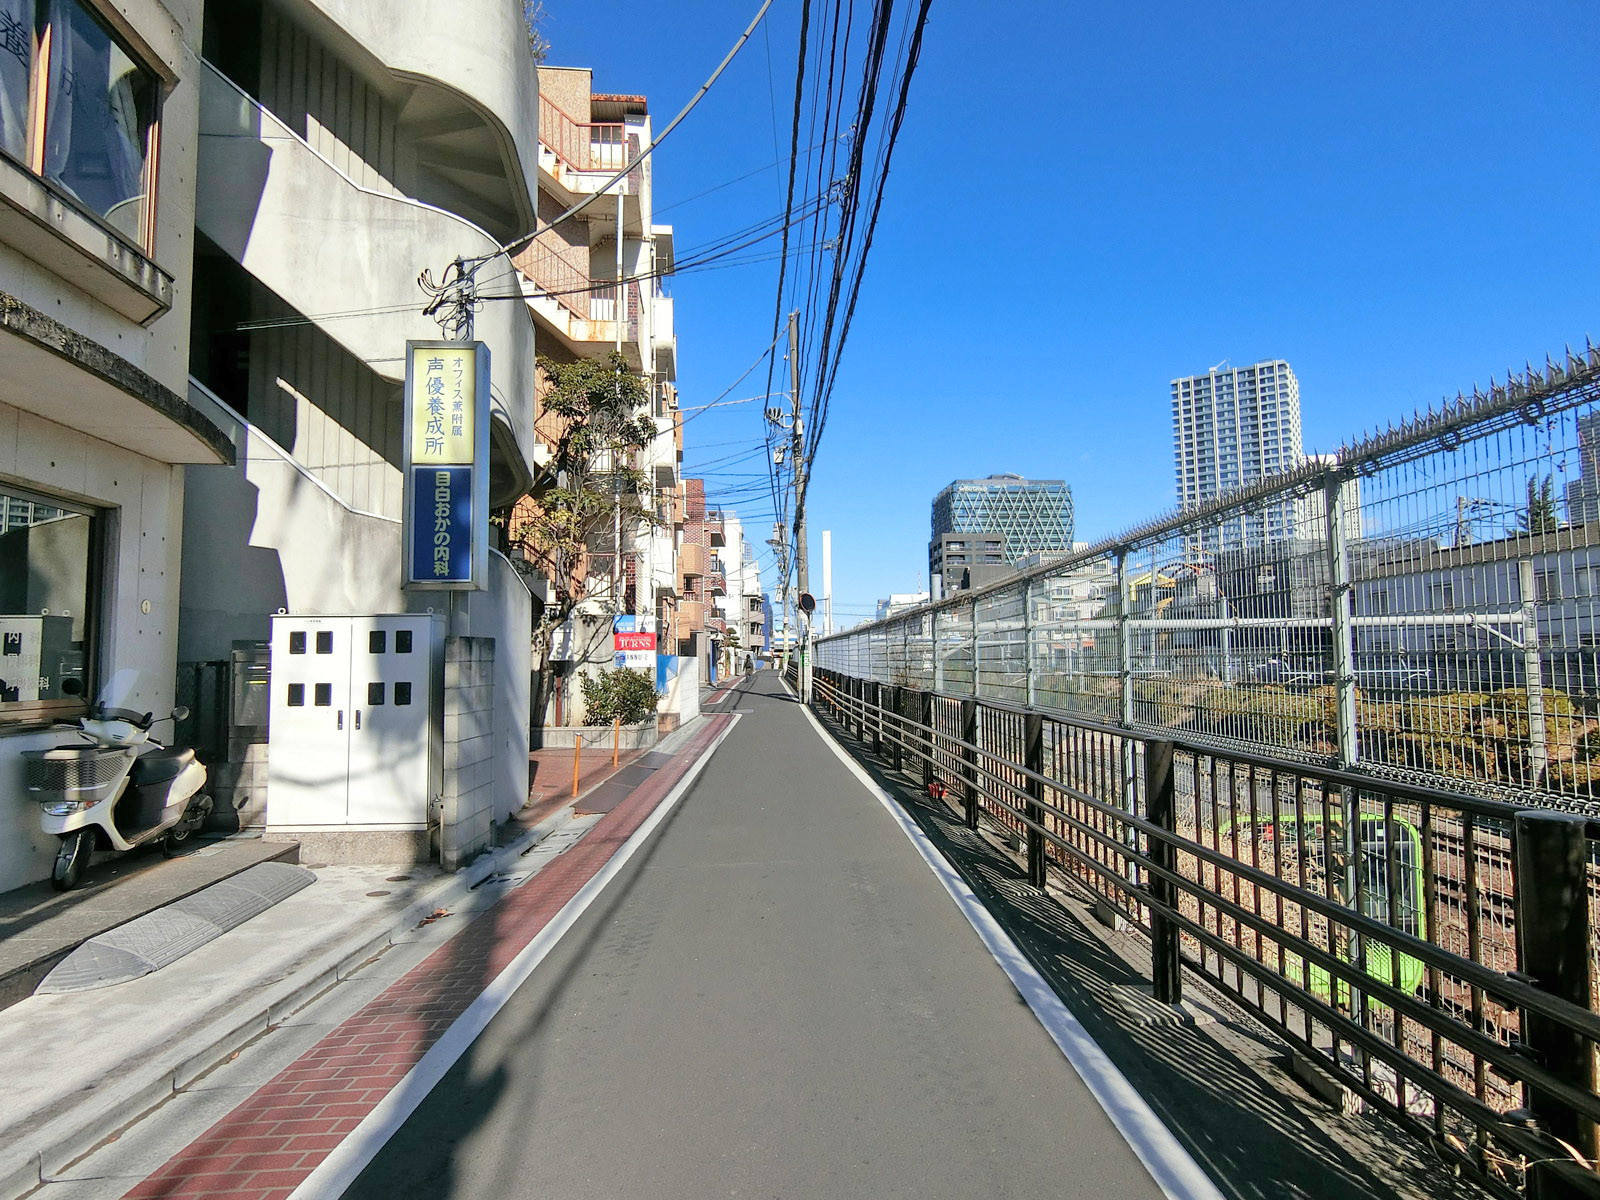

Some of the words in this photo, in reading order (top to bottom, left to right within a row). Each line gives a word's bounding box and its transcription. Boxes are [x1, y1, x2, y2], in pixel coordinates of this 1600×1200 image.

[424, 357, 446, 456] 声優養成所
[451, 357, 463, 437] オフィス薫附属
[433, 471, 451, 577] 目白おかの内科
